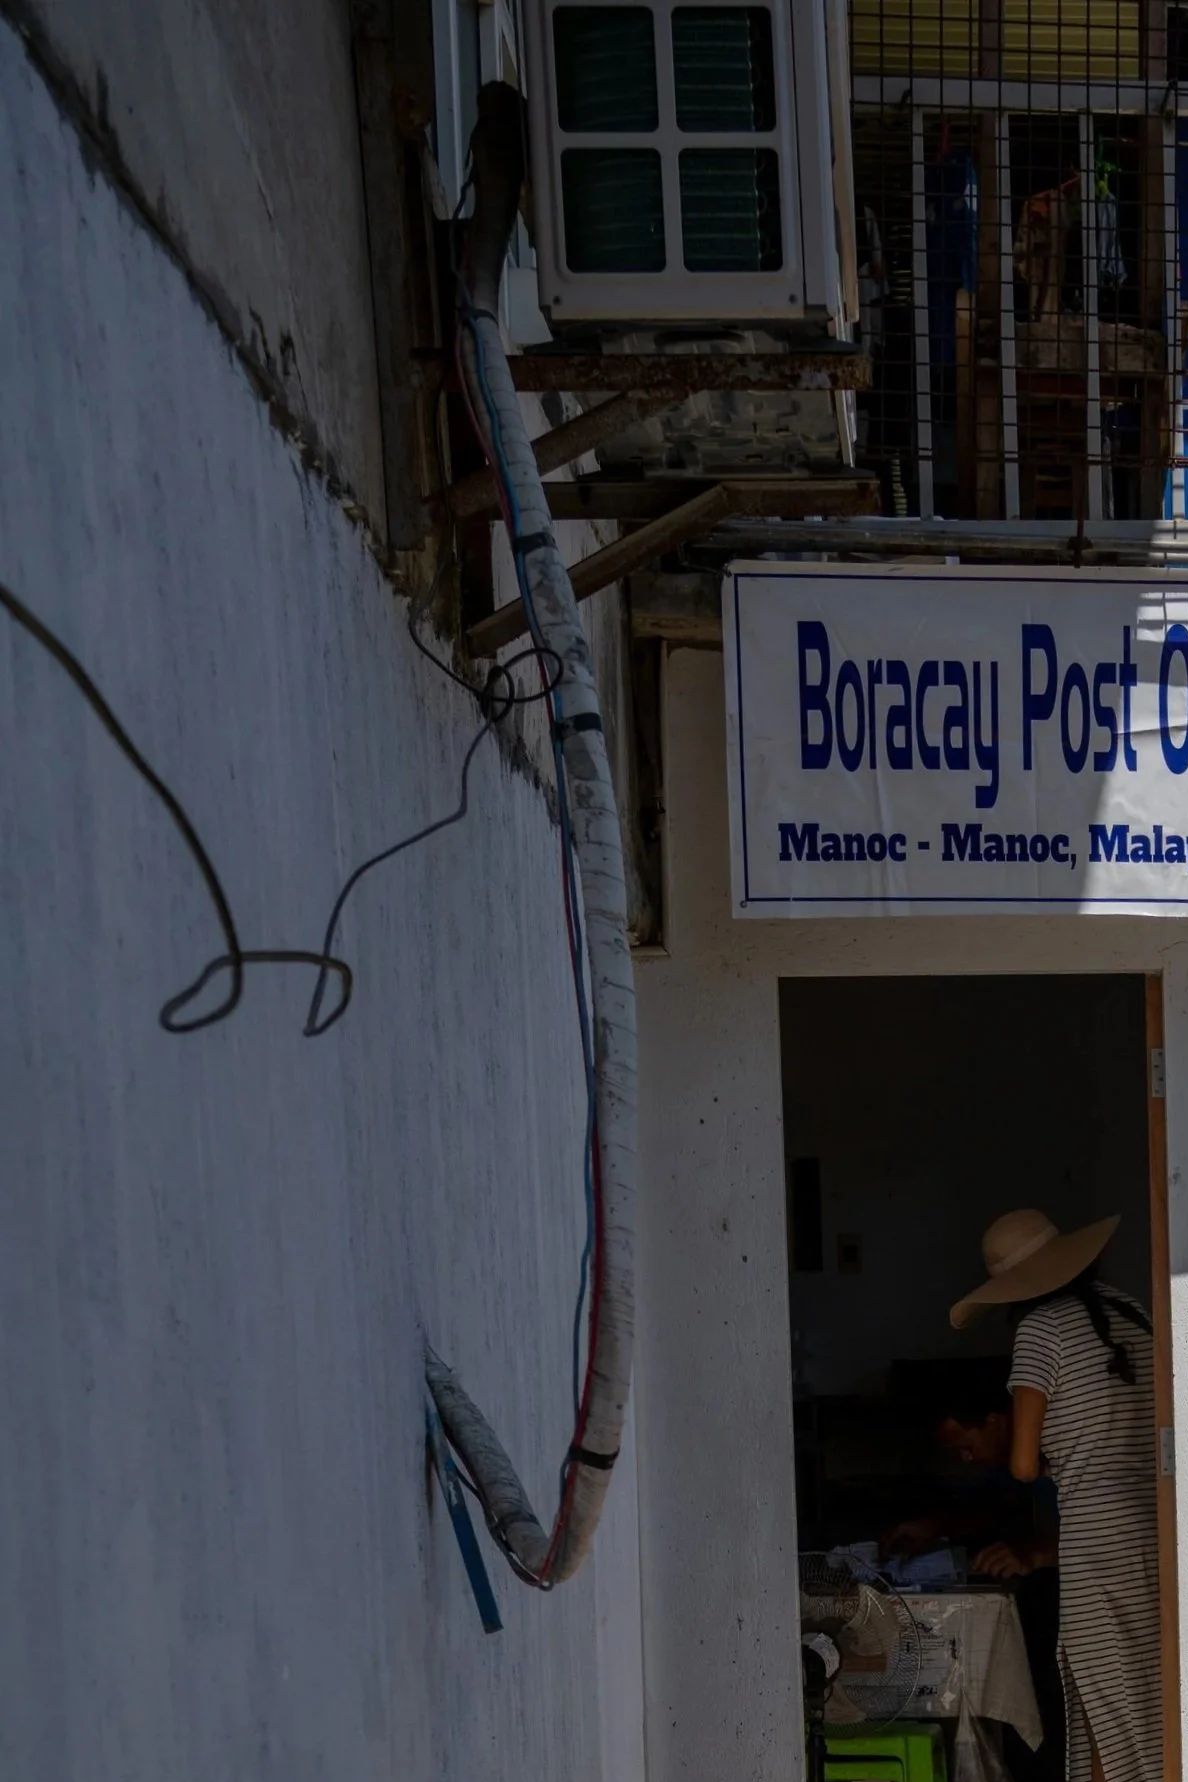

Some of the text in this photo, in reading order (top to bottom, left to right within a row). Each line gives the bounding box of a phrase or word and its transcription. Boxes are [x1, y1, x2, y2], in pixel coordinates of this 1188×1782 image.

[797, 620, 999, 808] Boracay
[1021, 623, 1137, 774] Post
[778, 822, 907, 863] Manoc
[941, 822, 1077, 870] Manoc,
